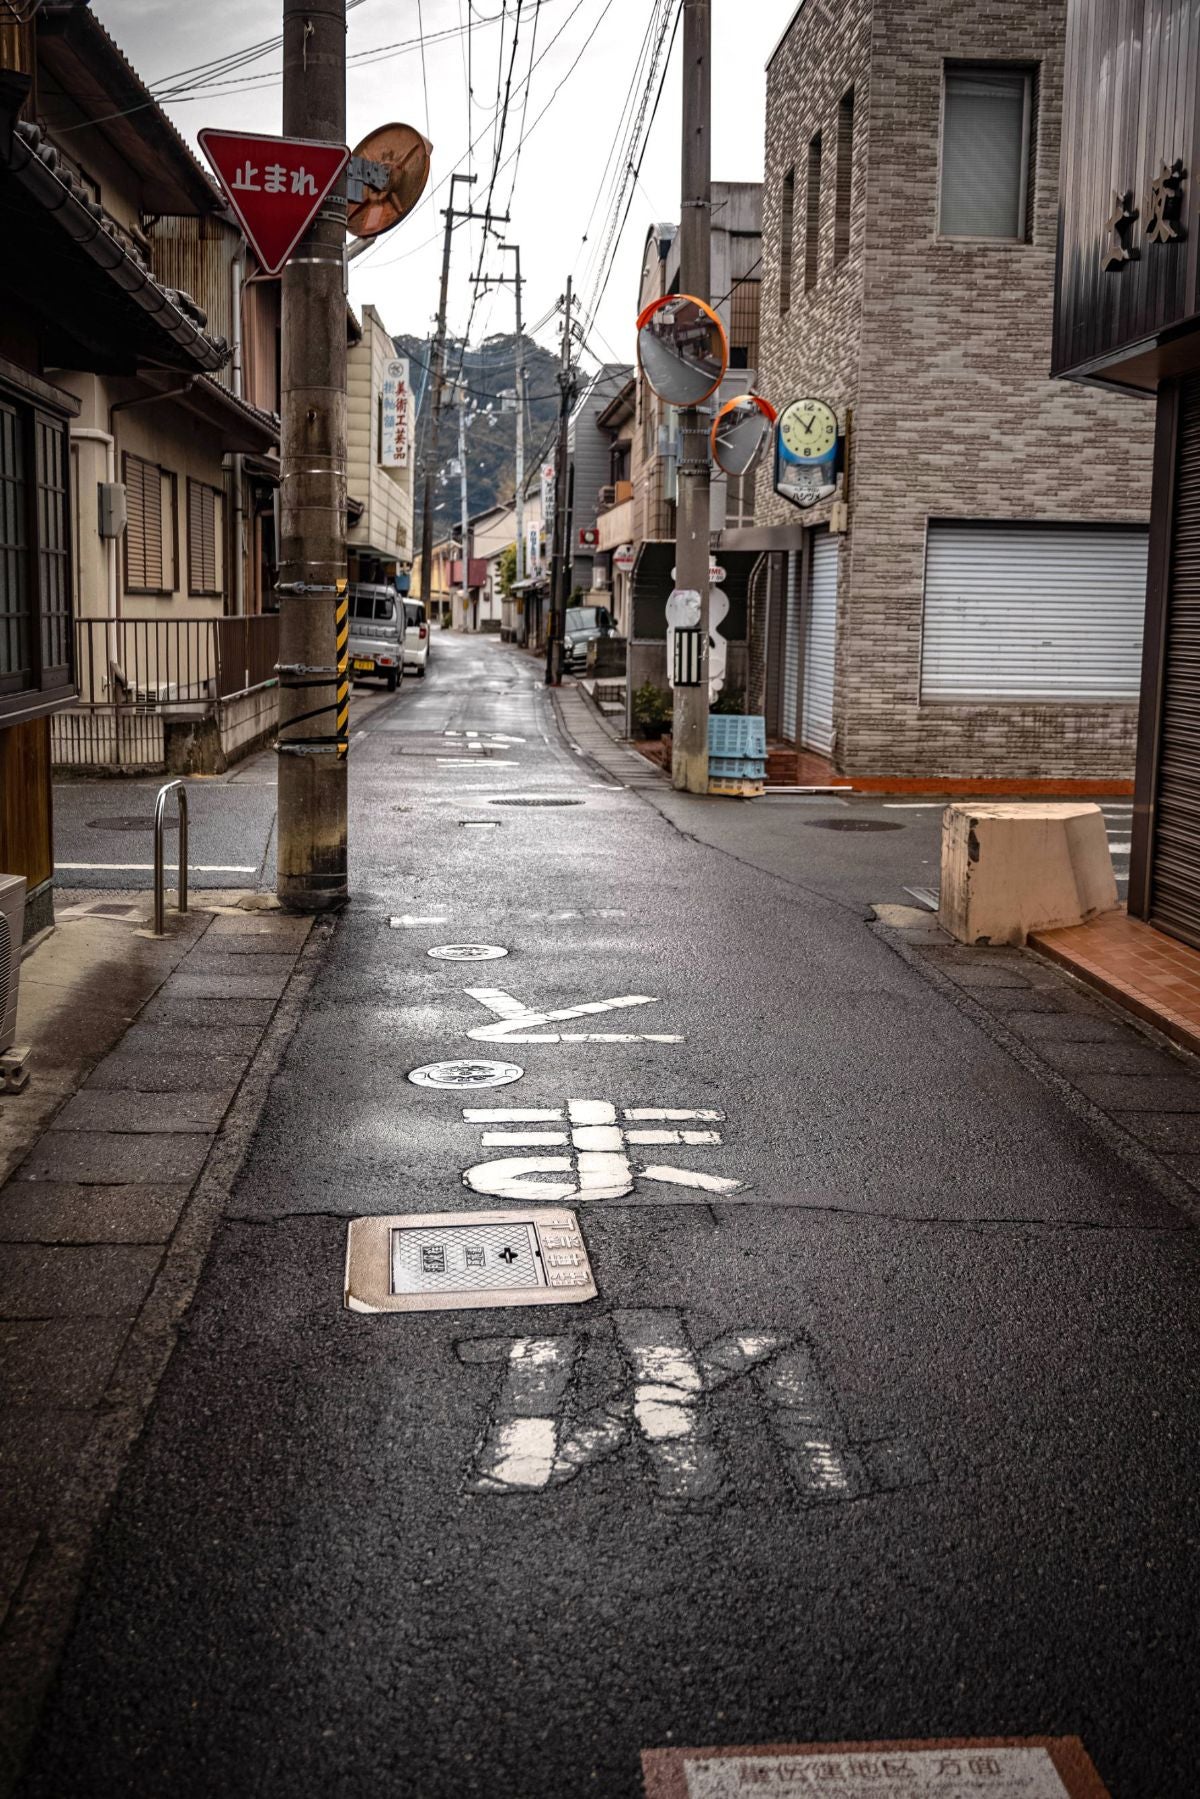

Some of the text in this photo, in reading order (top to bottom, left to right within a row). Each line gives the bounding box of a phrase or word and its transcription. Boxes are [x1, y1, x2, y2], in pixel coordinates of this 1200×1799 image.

[231, 160, 319, 197] 止まれ
[804, 402, 815, 412] 12
[393, 381, 408, 460] 美術工芸品
[783, 424, 791, 433] 9
[826, 425, 834, 434] 3
[803, 447, 812, 456] 6
[934, 1755, 1004, 1777] 方面
